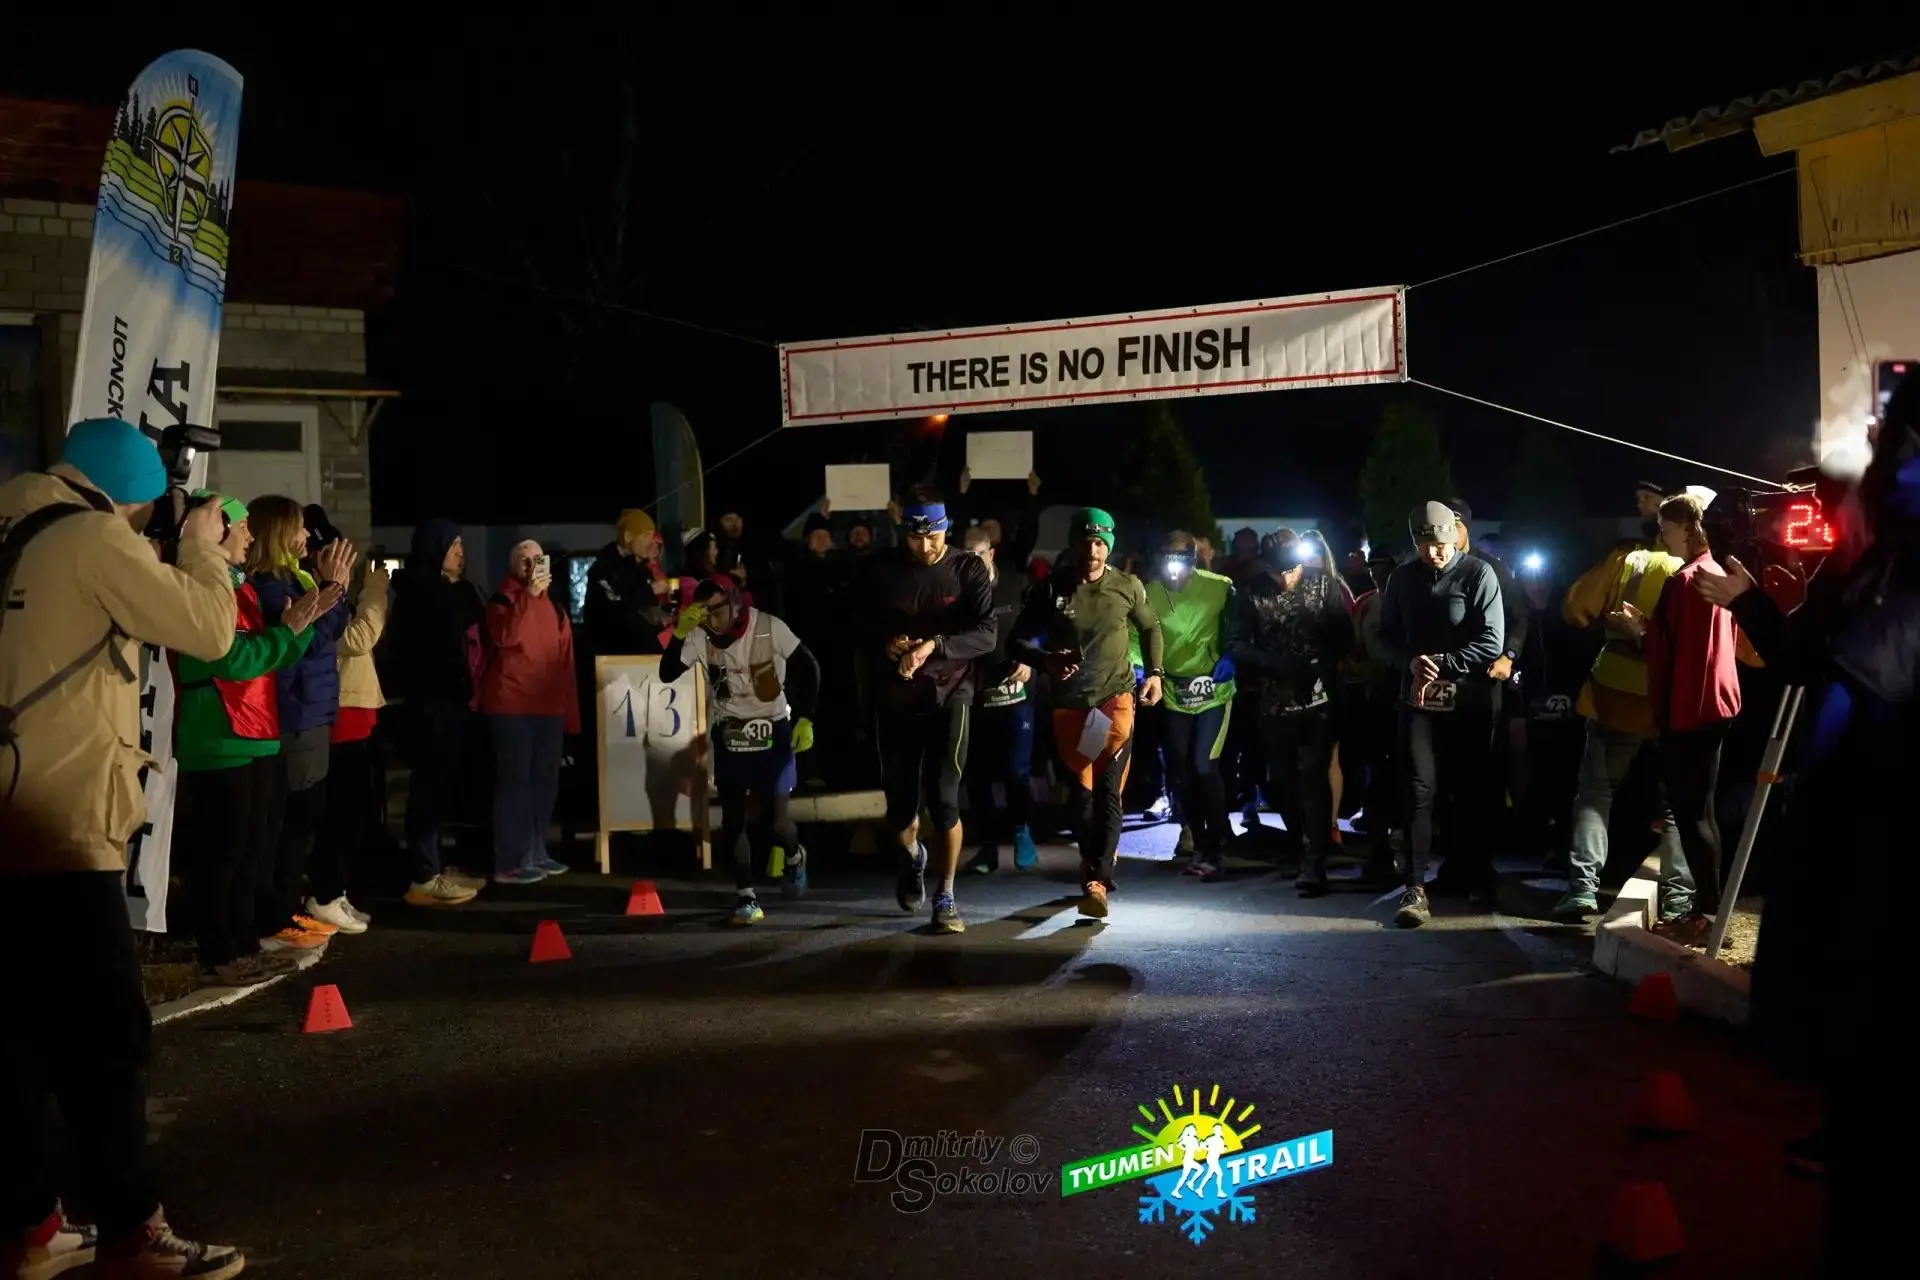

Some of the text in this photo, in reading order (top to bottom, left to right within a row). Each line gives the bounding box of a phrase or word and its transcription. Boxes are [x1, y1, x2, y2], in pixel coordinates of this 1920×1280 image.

[907, 326, 1250, 393] THERE IS NO FINISH
[1193, 679, 1213, 698] 28
[1430, 682, 1454, 702] 25
[749, 722, 770, 740] 30
